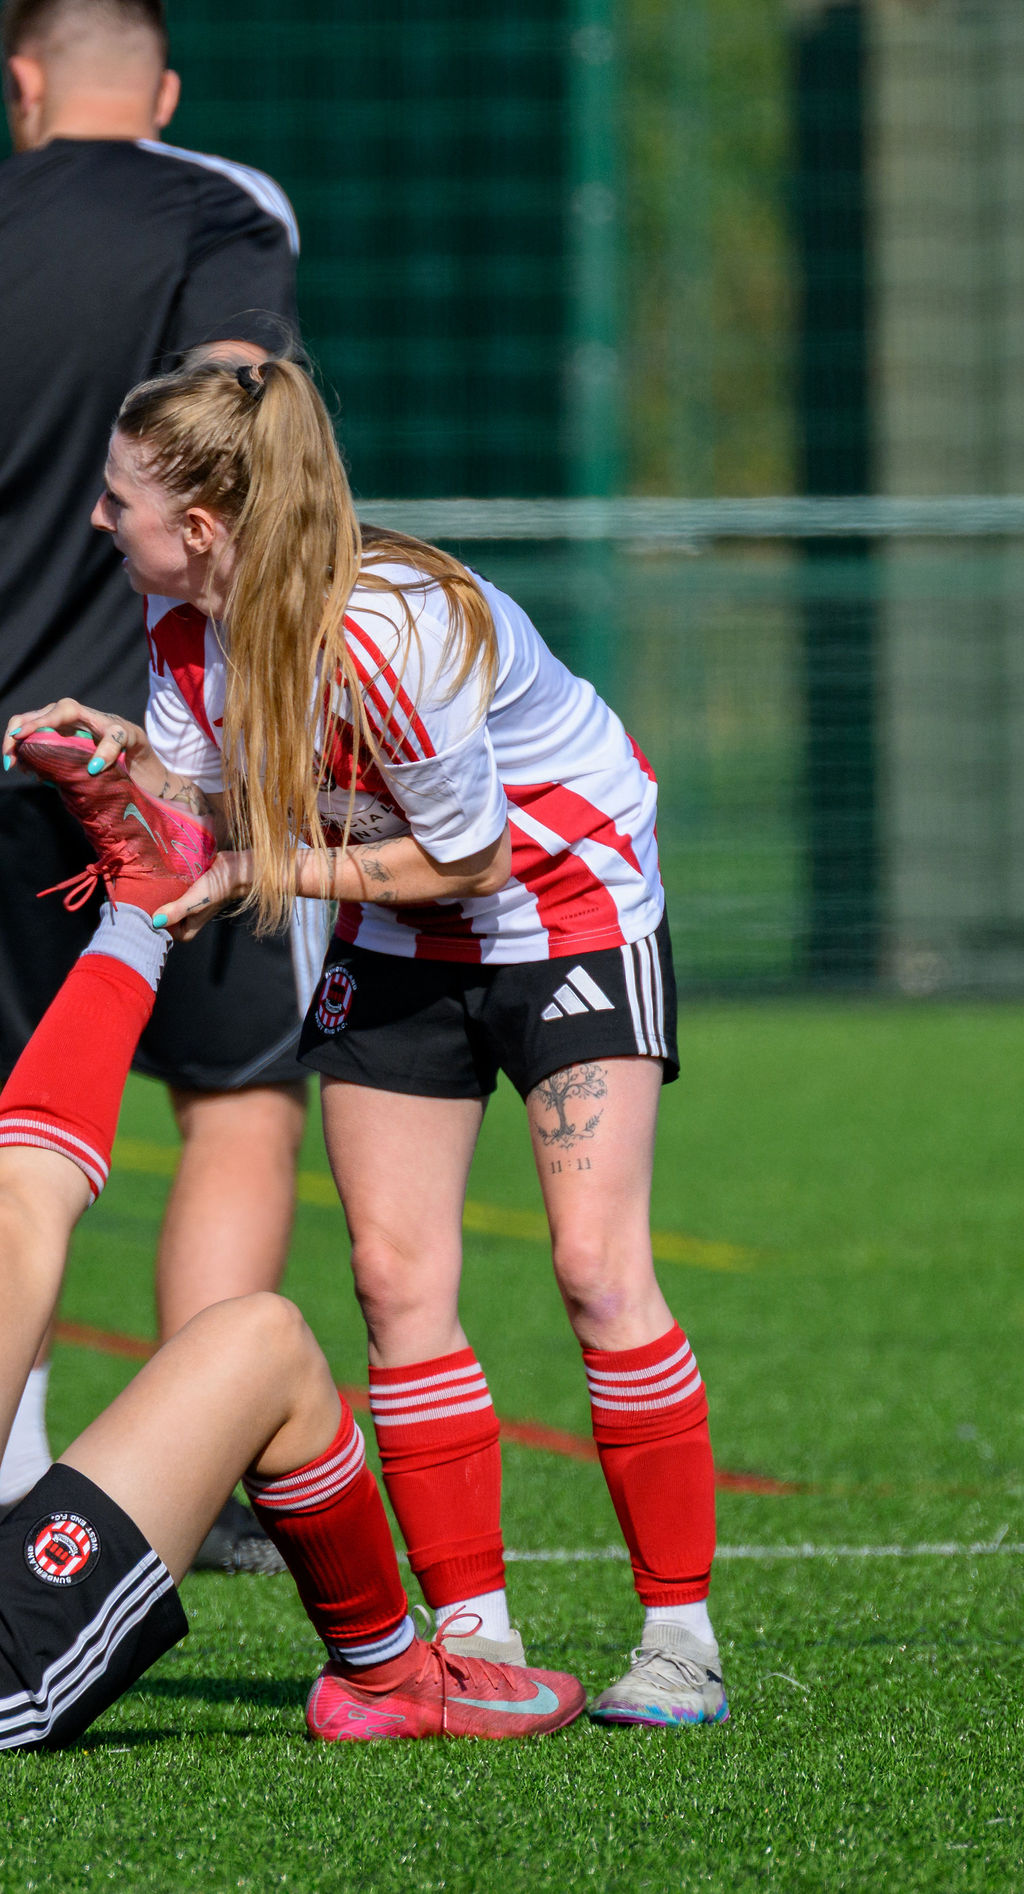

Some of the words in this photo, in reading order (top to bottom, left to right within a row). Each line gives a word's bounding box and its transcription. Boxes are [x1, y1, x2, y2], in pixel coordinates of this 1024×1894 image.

[70, 1513, 88, 1527] END
[85, 1526, 99, 1553] WEST
[27, 1544, 72, 1584] SUNDERLAND
